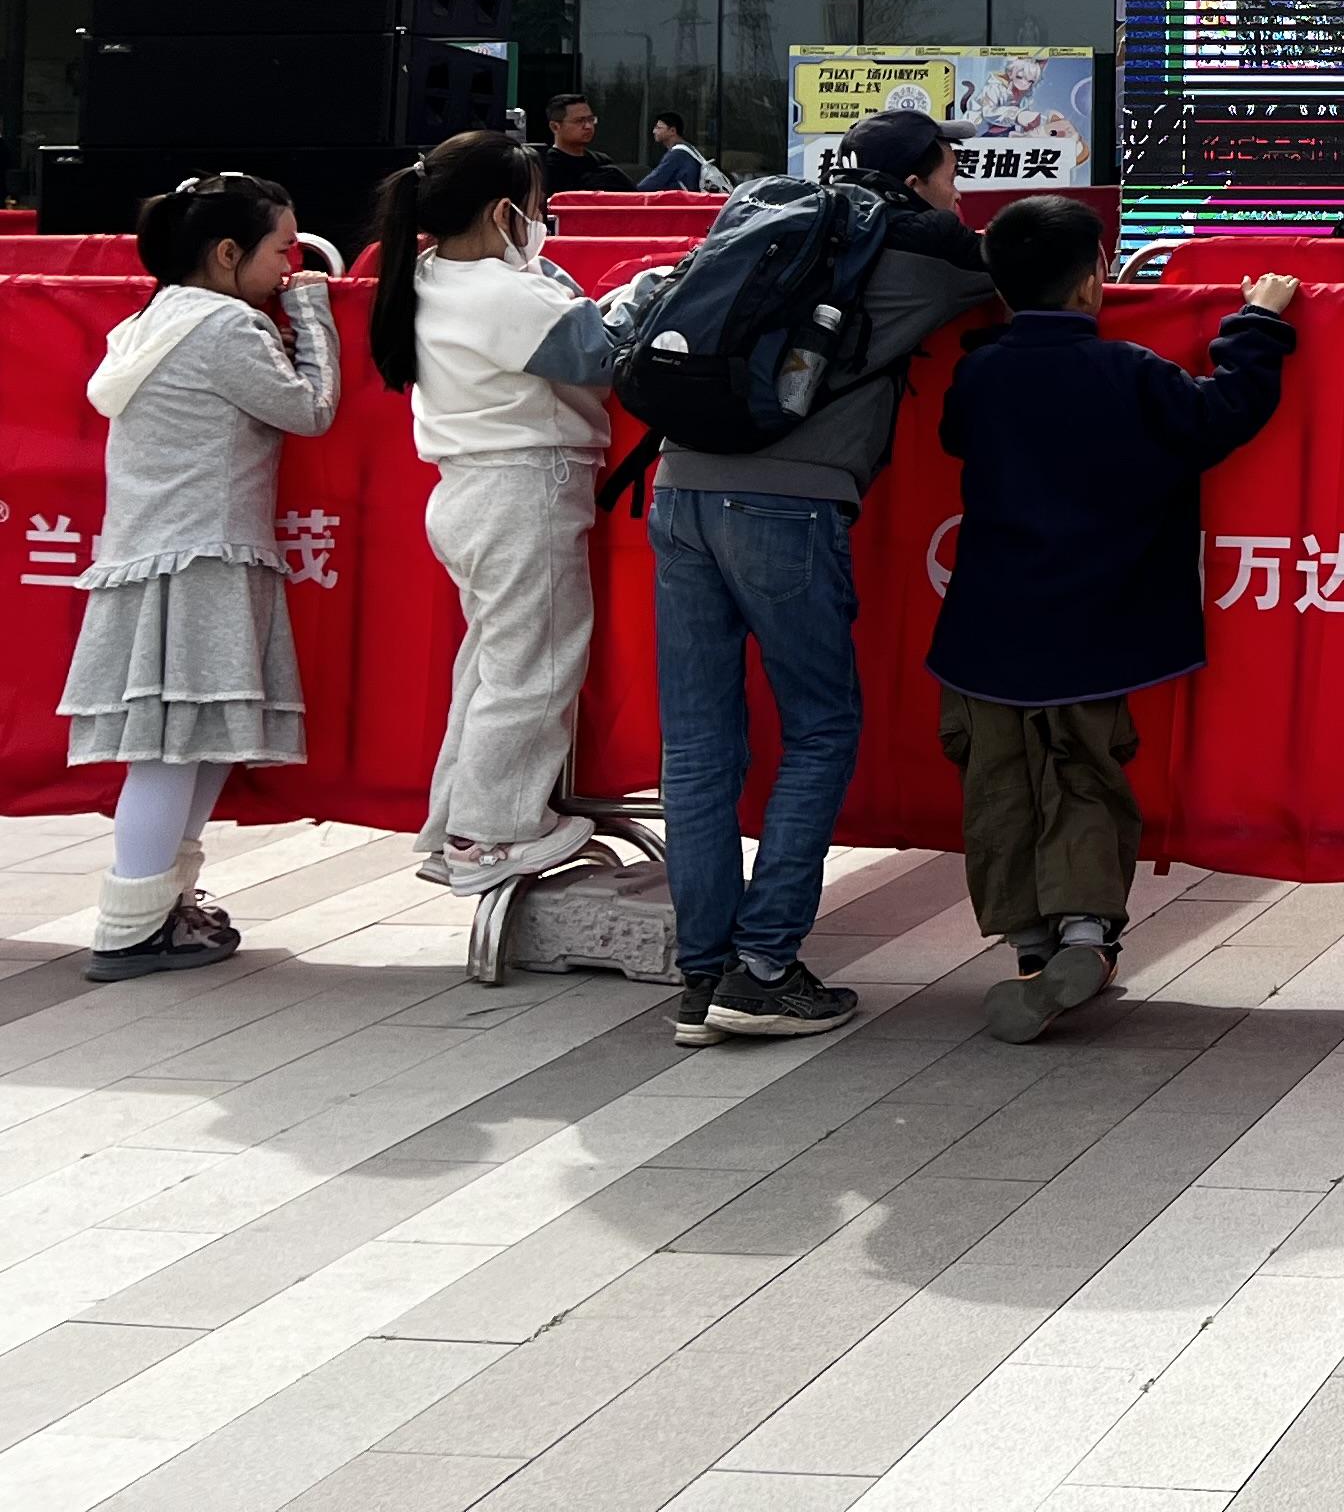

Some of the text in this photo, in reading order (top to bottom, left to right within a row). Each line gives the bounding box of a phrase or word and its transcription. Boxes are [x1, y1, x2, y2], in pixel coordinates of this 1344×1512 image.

[819, 68, 929, 81] 万达广场小程序
